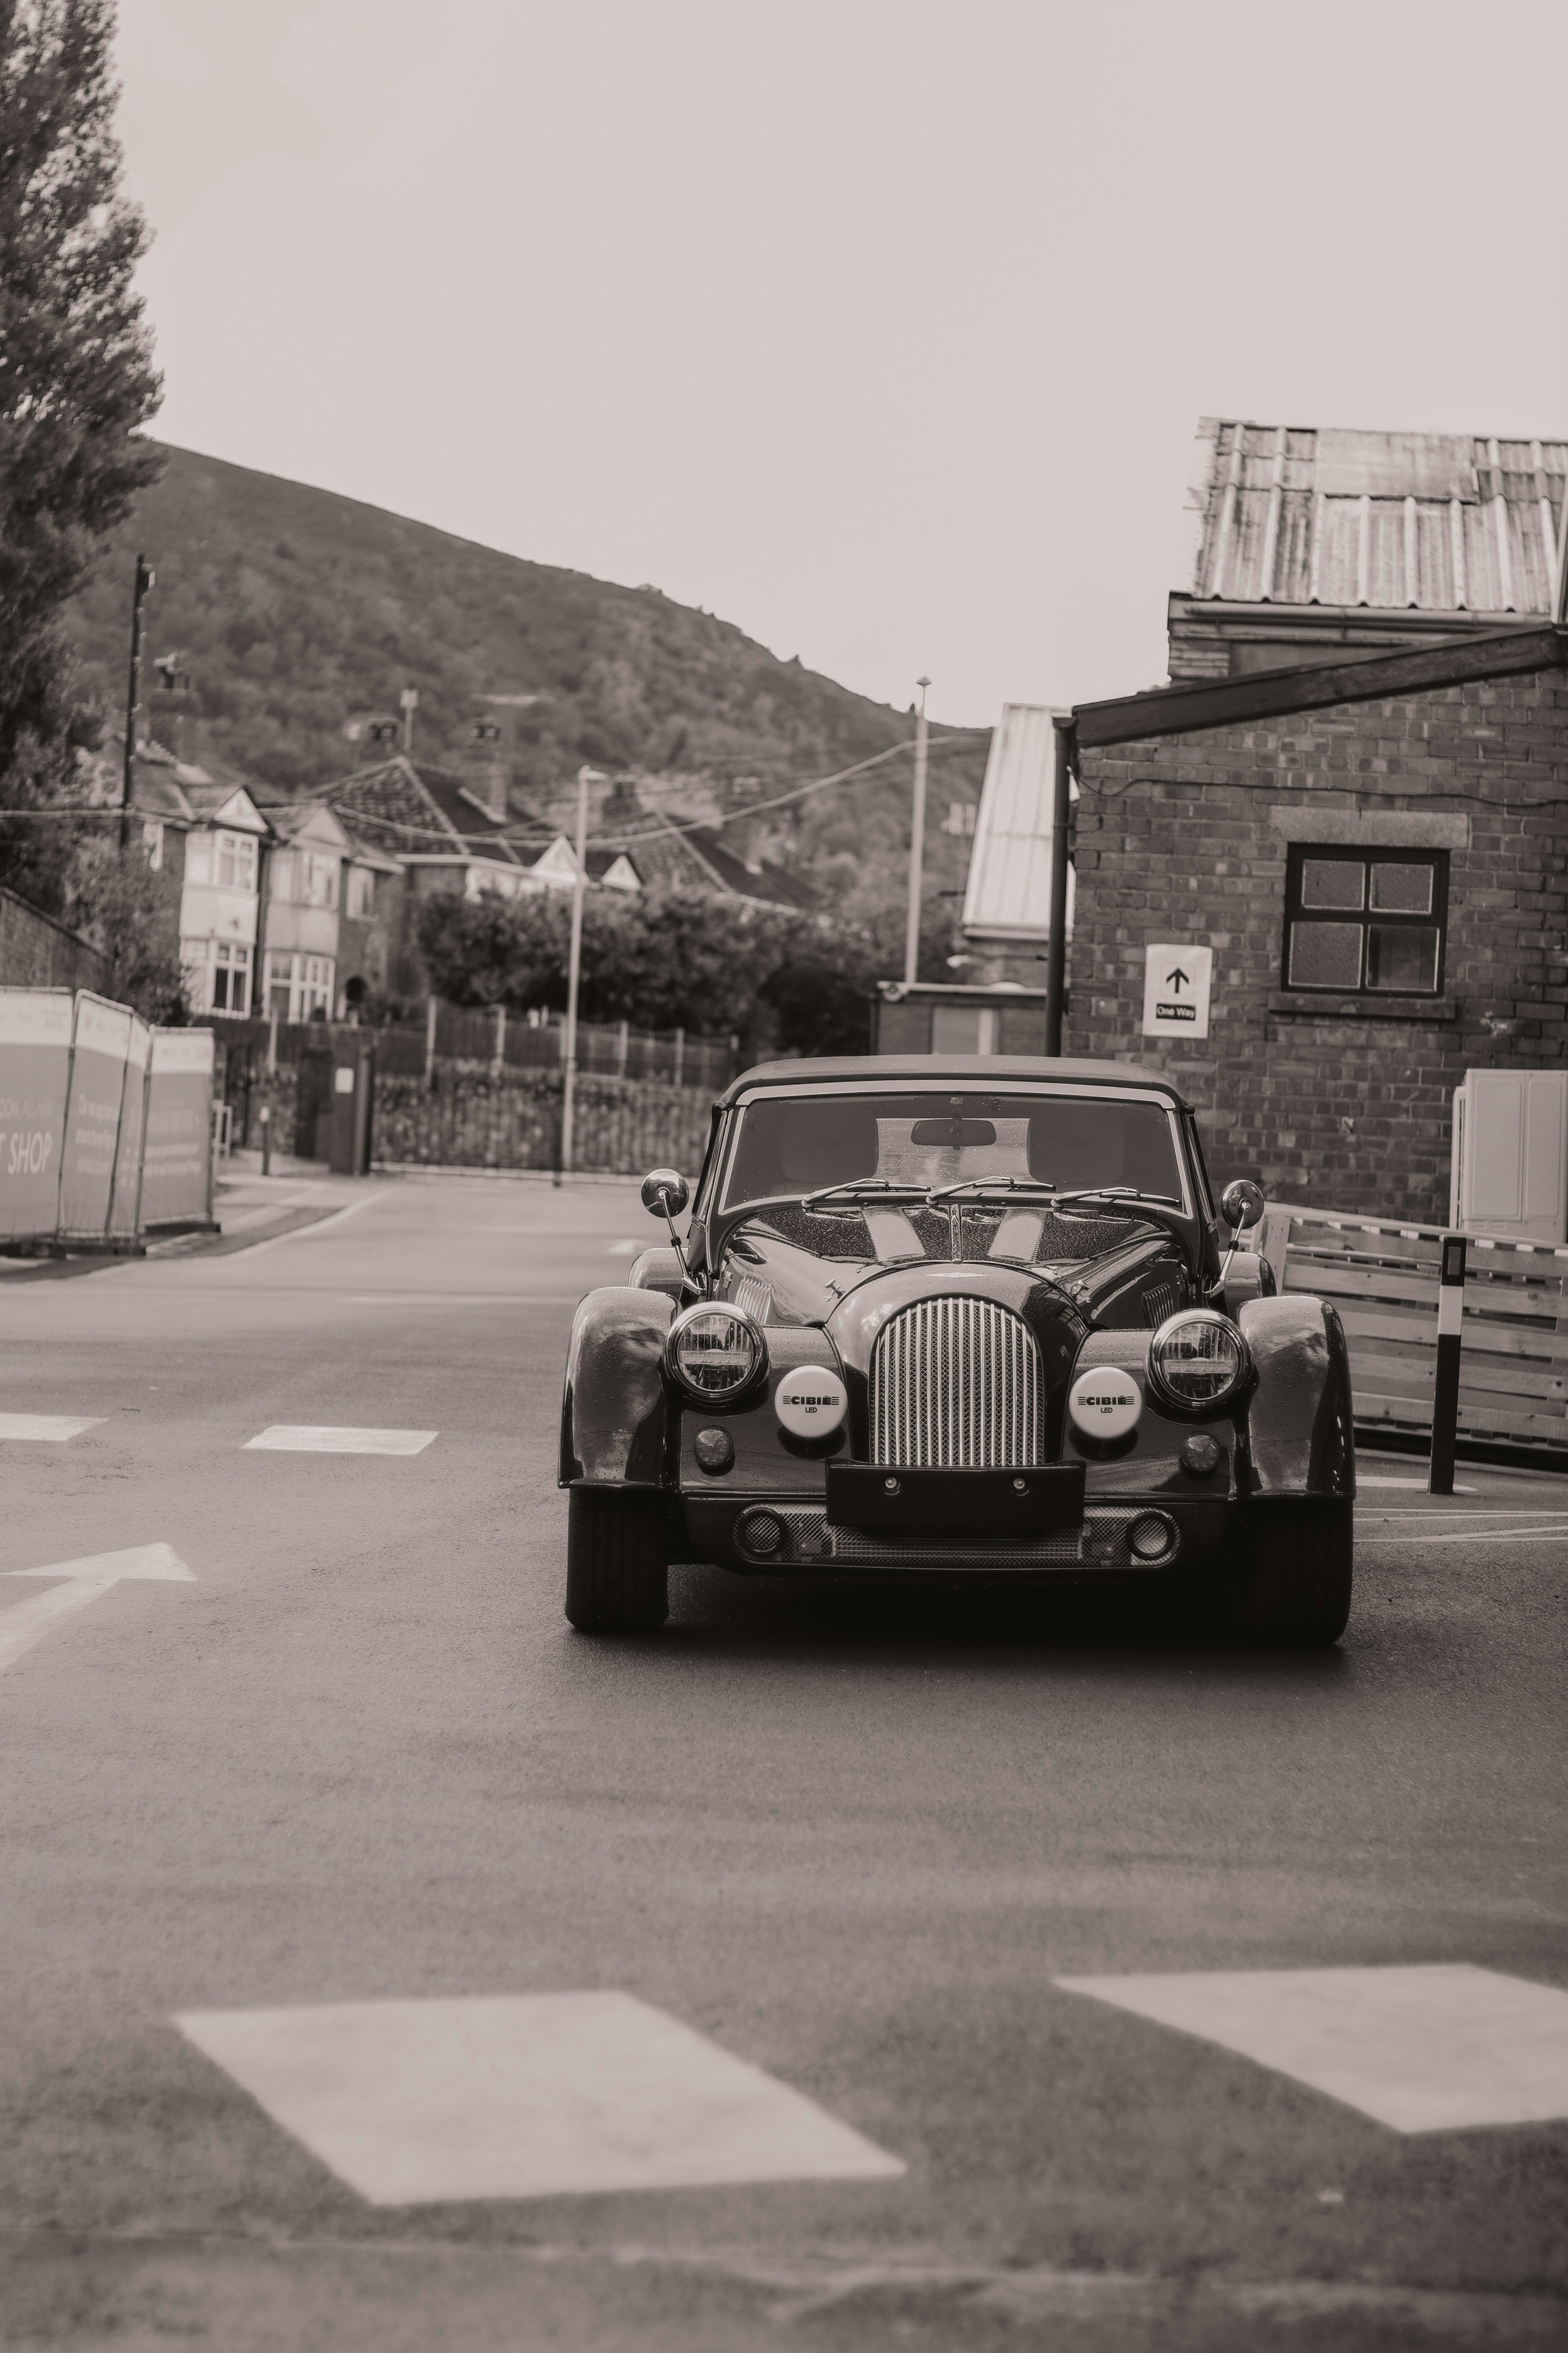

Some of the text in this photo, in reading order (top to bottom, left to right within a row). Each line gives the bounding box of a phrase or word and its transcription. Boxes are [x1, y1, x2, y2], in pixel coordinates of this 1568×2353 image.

[1157, 1006, 1195, 1018] One Way
[8, 1131, 53, 1175] SHOP
